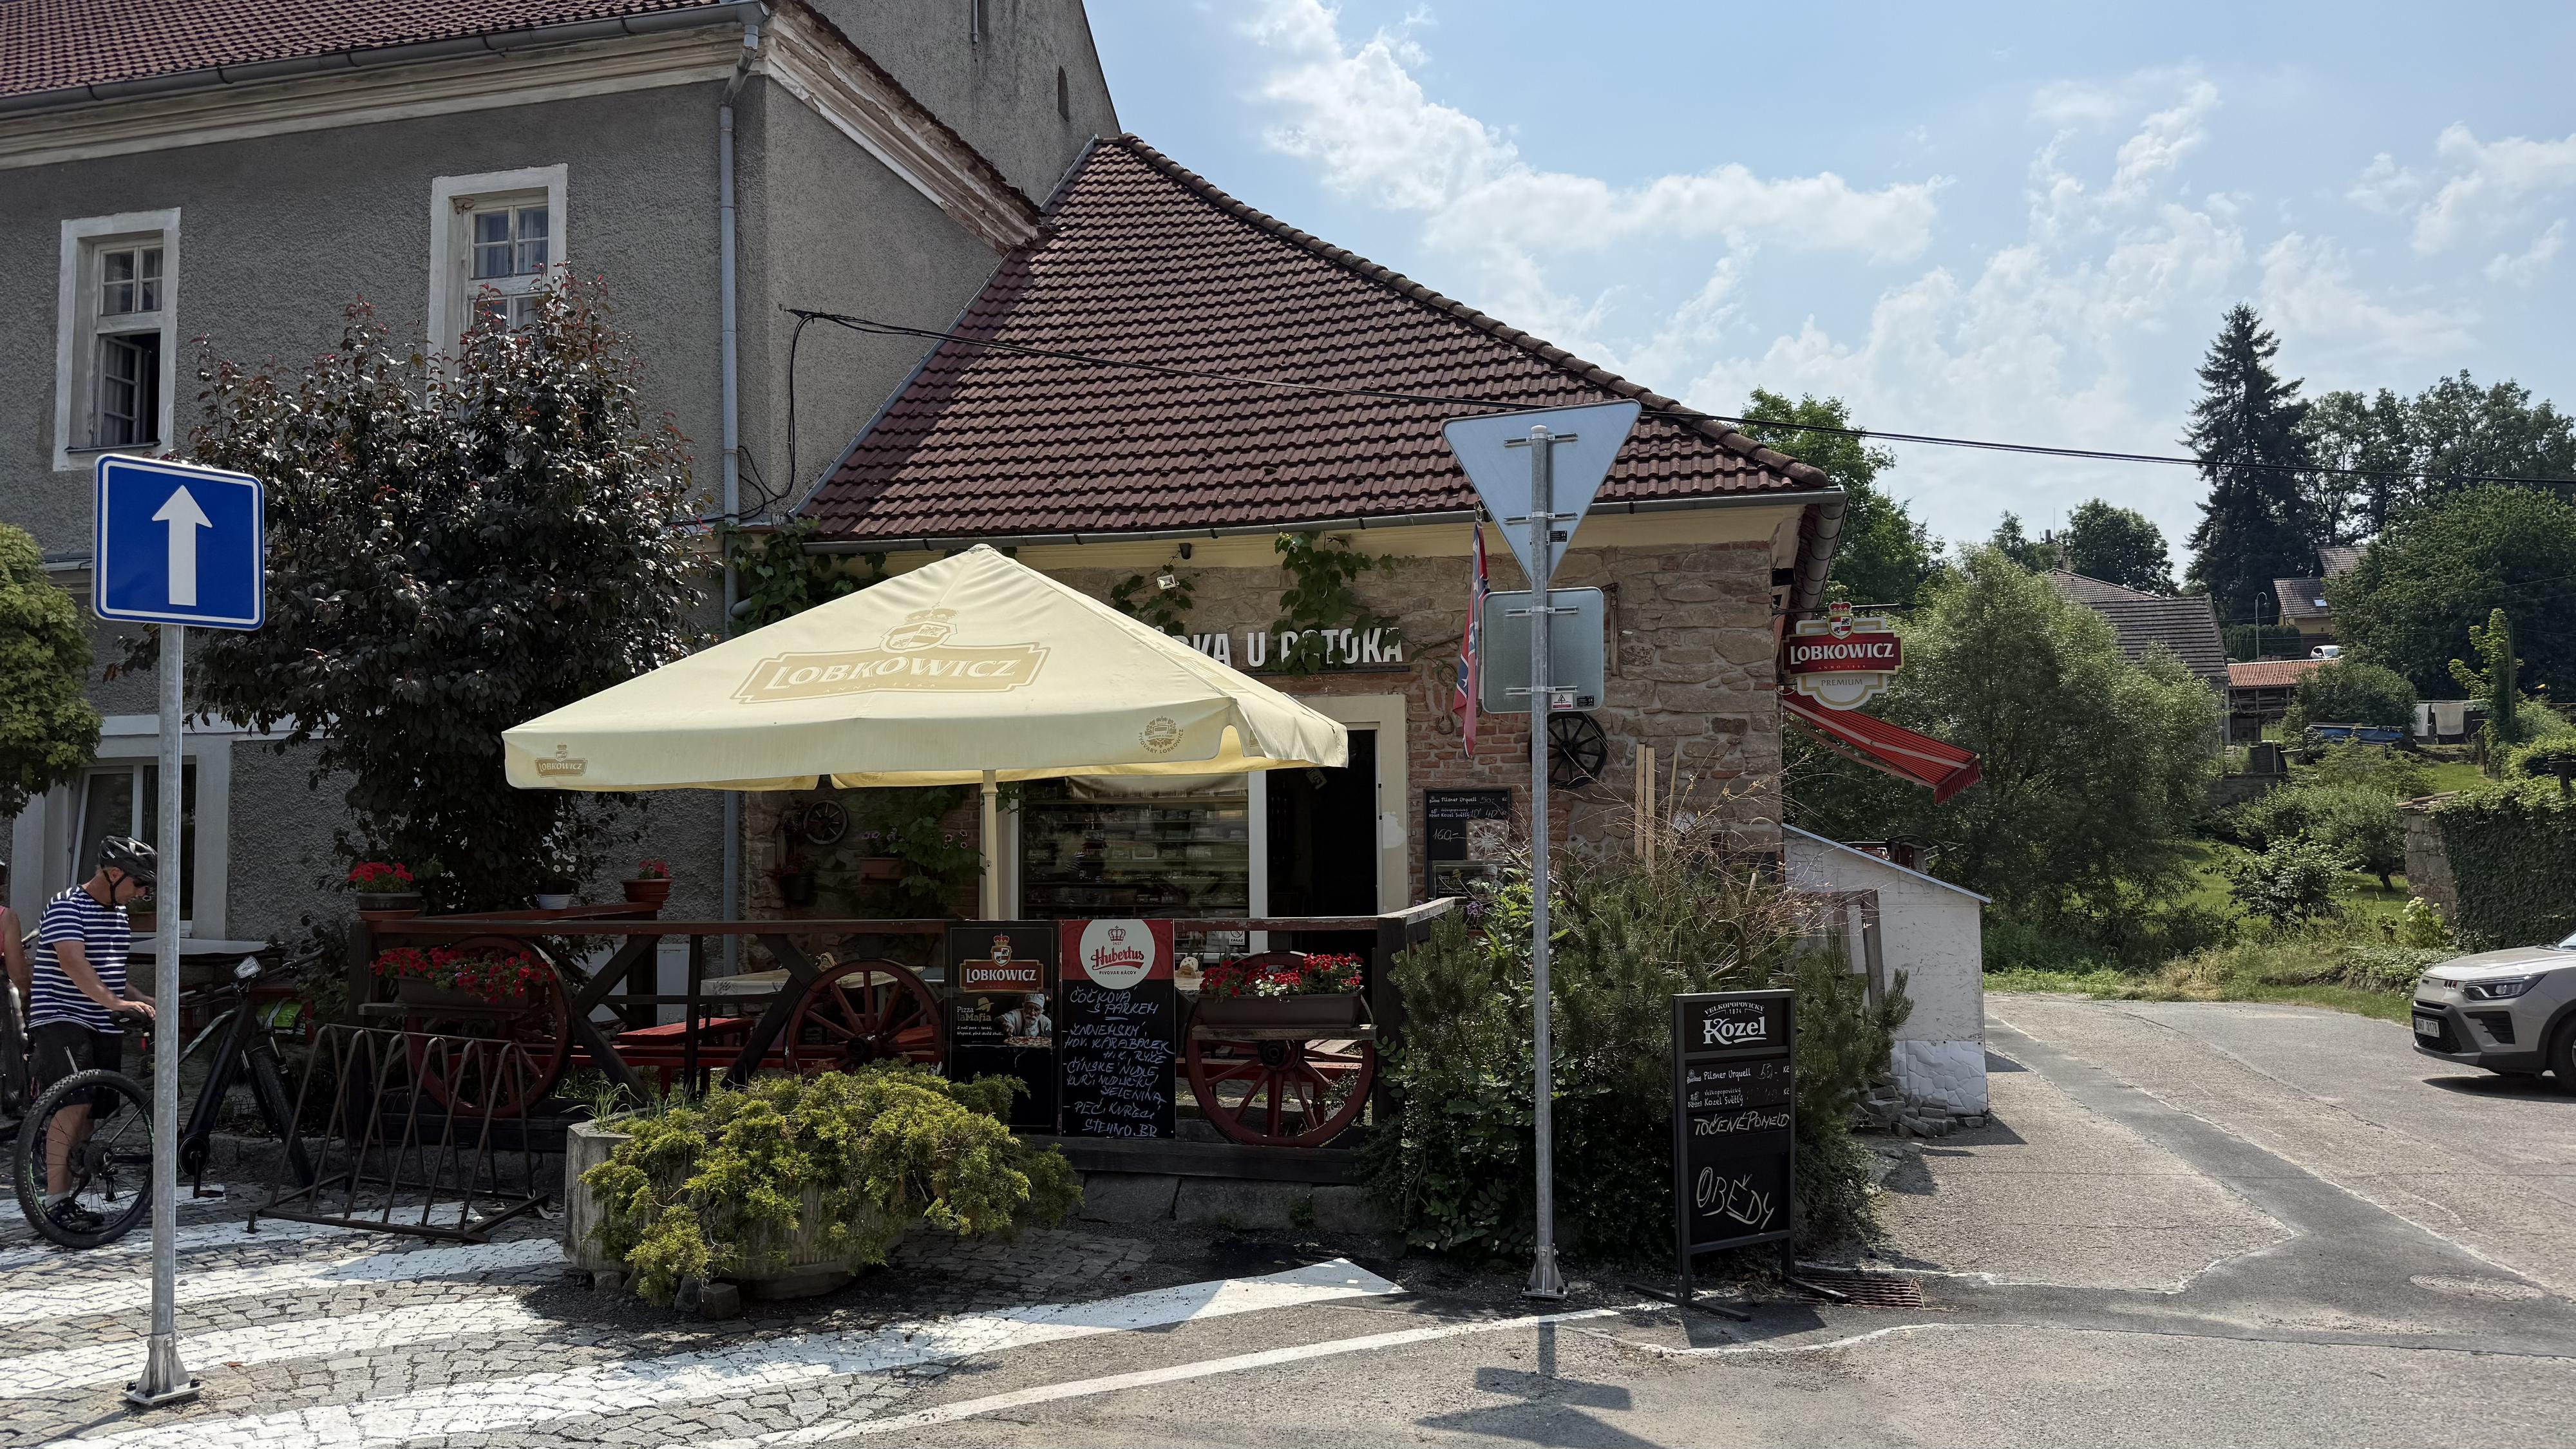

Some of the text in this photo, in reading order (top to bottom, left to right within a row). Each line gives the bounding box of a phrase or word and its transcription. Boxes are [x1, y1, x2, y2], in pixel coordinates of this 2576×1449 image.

[1247, 632, 1265, 667] U
[1790, 643, 1894, 665] LOBKOWICZ
[762, 656, 1021, 691] LOBKOWICZ
[1821, 678, 1862, 687] PREMIUM
[1139, 728, 1184, 754] PIVOVARY LOBKOWICZ
[538, 762, 583, 772] LOBKOWICZ
[1459, 796, 1477, 804] Urquell
[1090, 945, 1144, 969] Hubertus
[966, 968, 1037, 983] LOBKOWICZ
[1704, 1001, 1765, 1016] VELKOPOPOVICKÝ
[1703, 1016, 1766, 1045] Kozel
[1703, 1070, 1726, 1081] Pilsner
[1728, 1068, 1751, 1082] Urquell
[1783, 1065, 1790, 1074] Kč
[1704, 1087, 1741, 1097] Velkopopovický
[1704, 1098, 1722, 1106] Kozel
[1725, 1094, 1743, 1106] Světlý
[1696, 1167, 1774, 1229] OBĚDY
